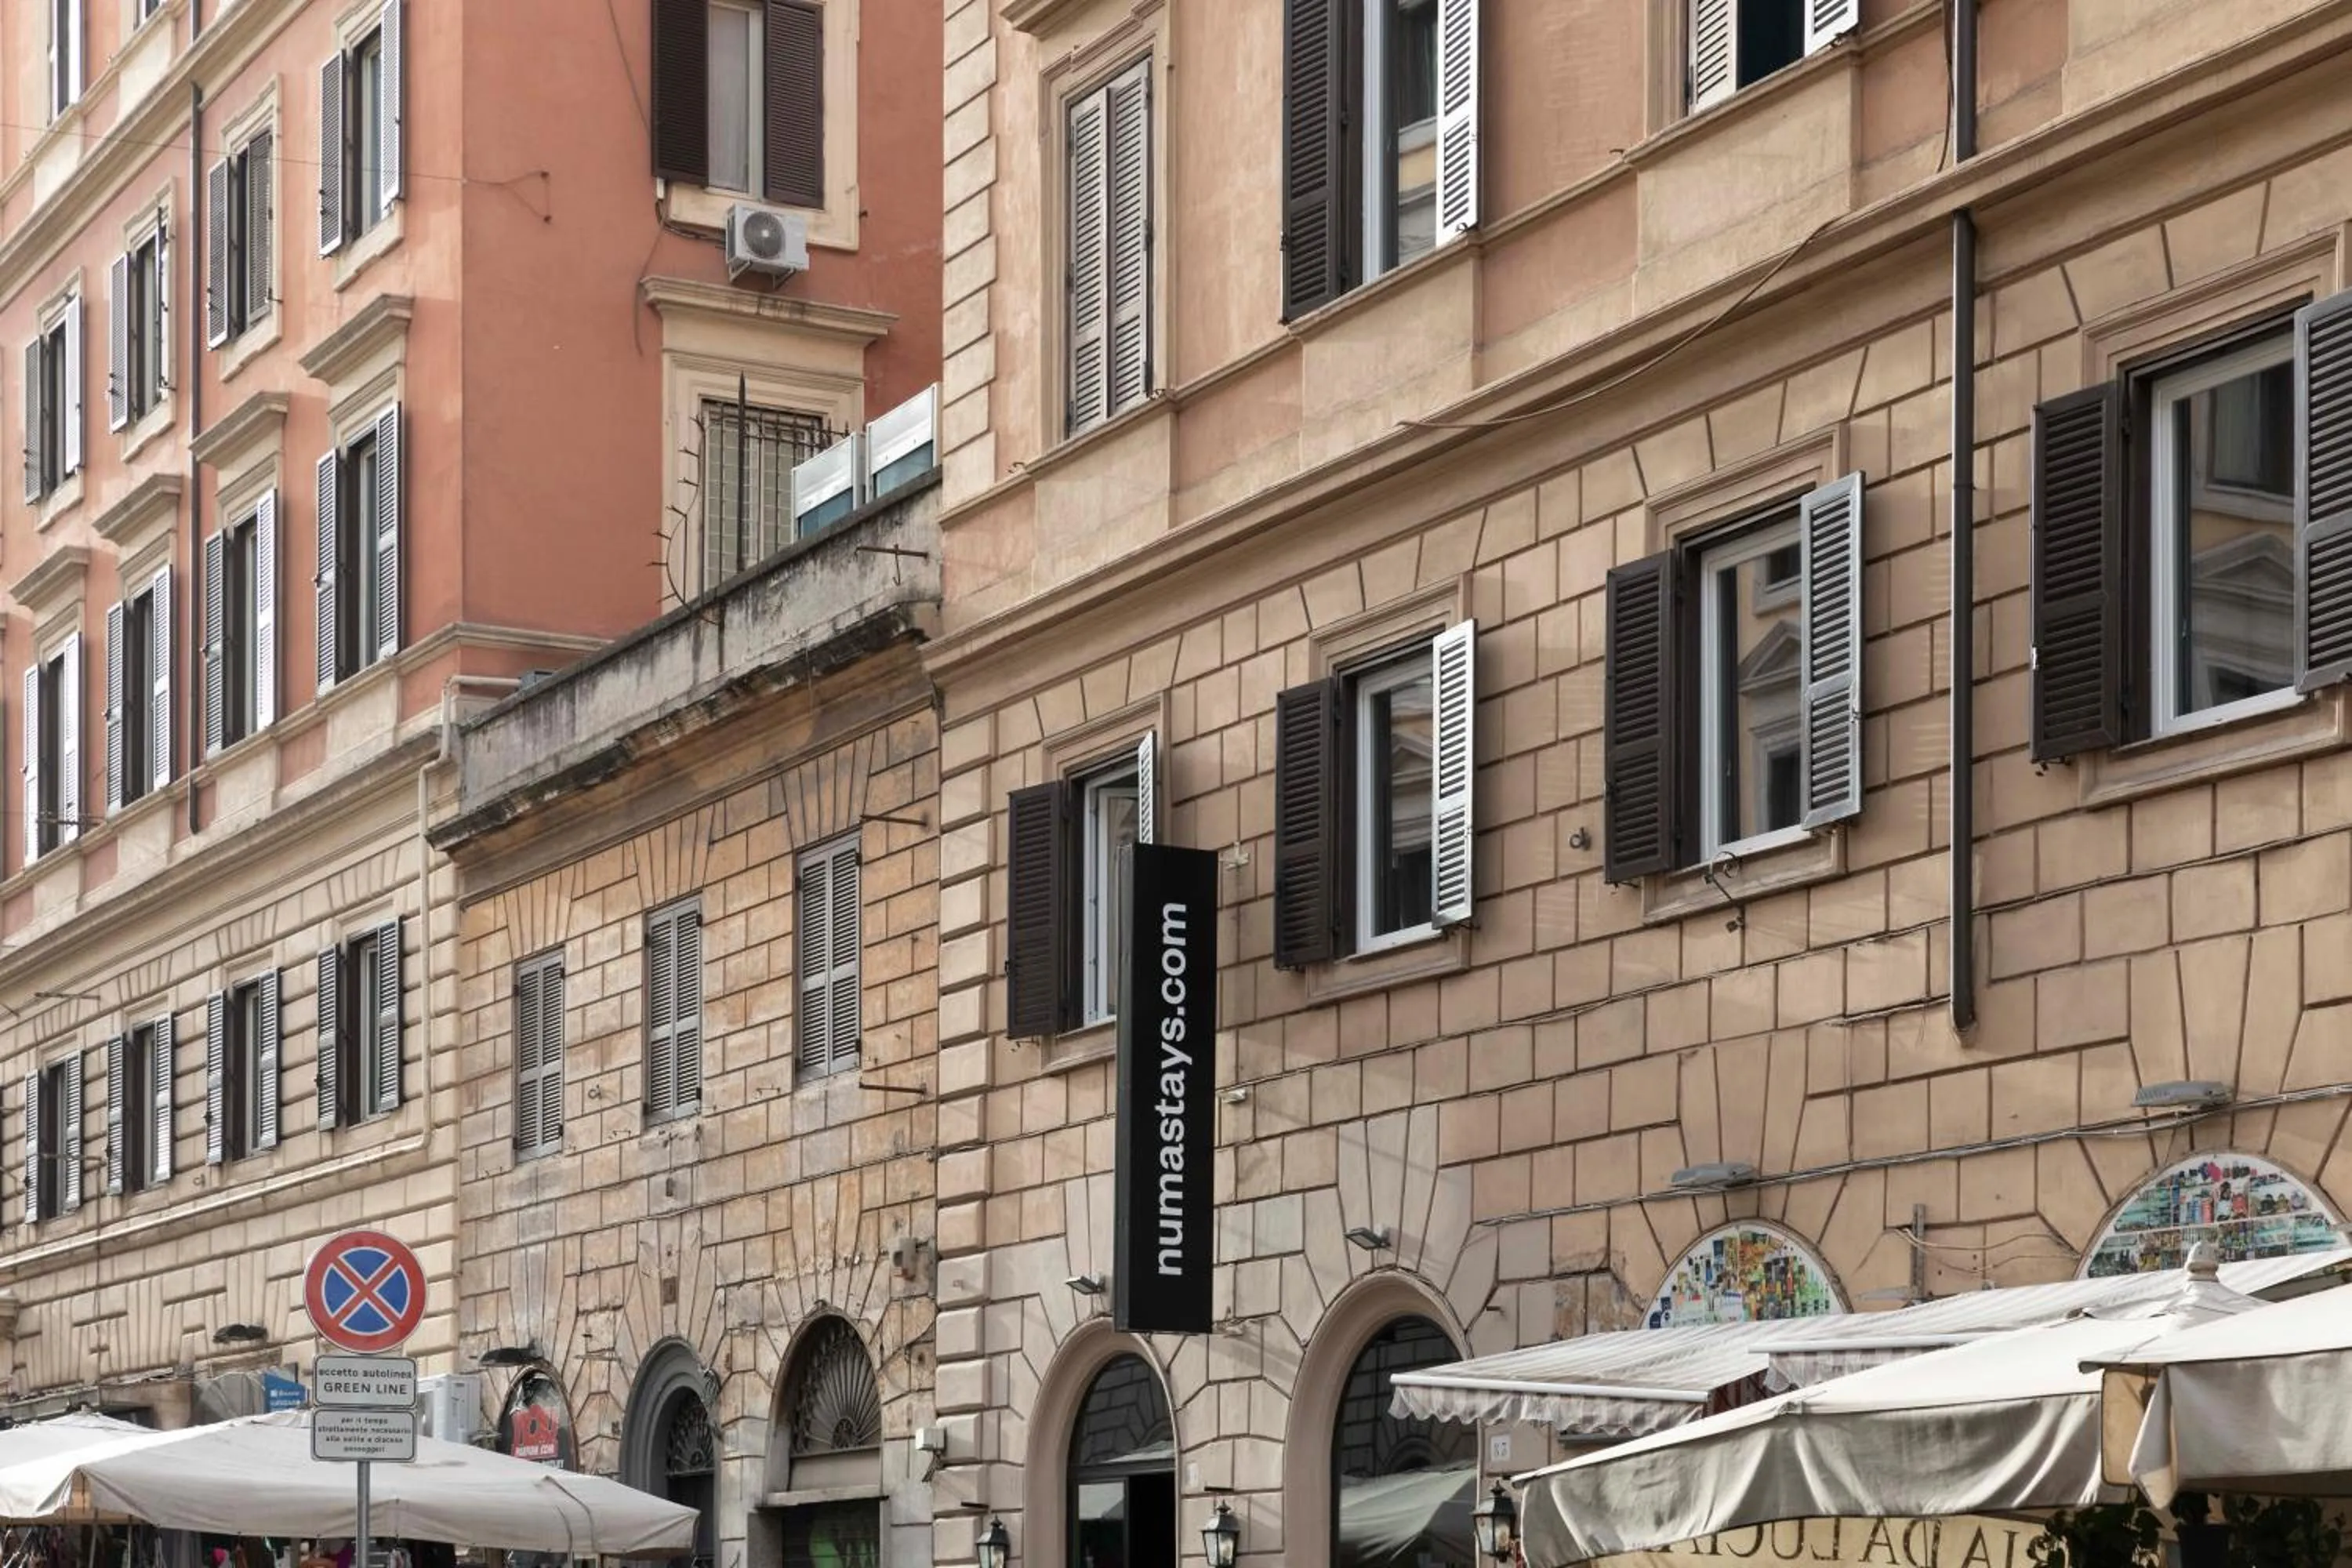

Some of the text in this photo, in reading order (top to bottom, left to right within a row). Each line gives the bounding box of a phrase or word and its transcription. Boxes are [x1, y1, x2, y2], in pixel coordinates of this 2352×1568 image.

[1154, 902, 1192, 1276] numastays.com
[318, 1368, 412, 1378] eccetto autolinea
[324, 1382, 408, 1395] GREEN LINE
